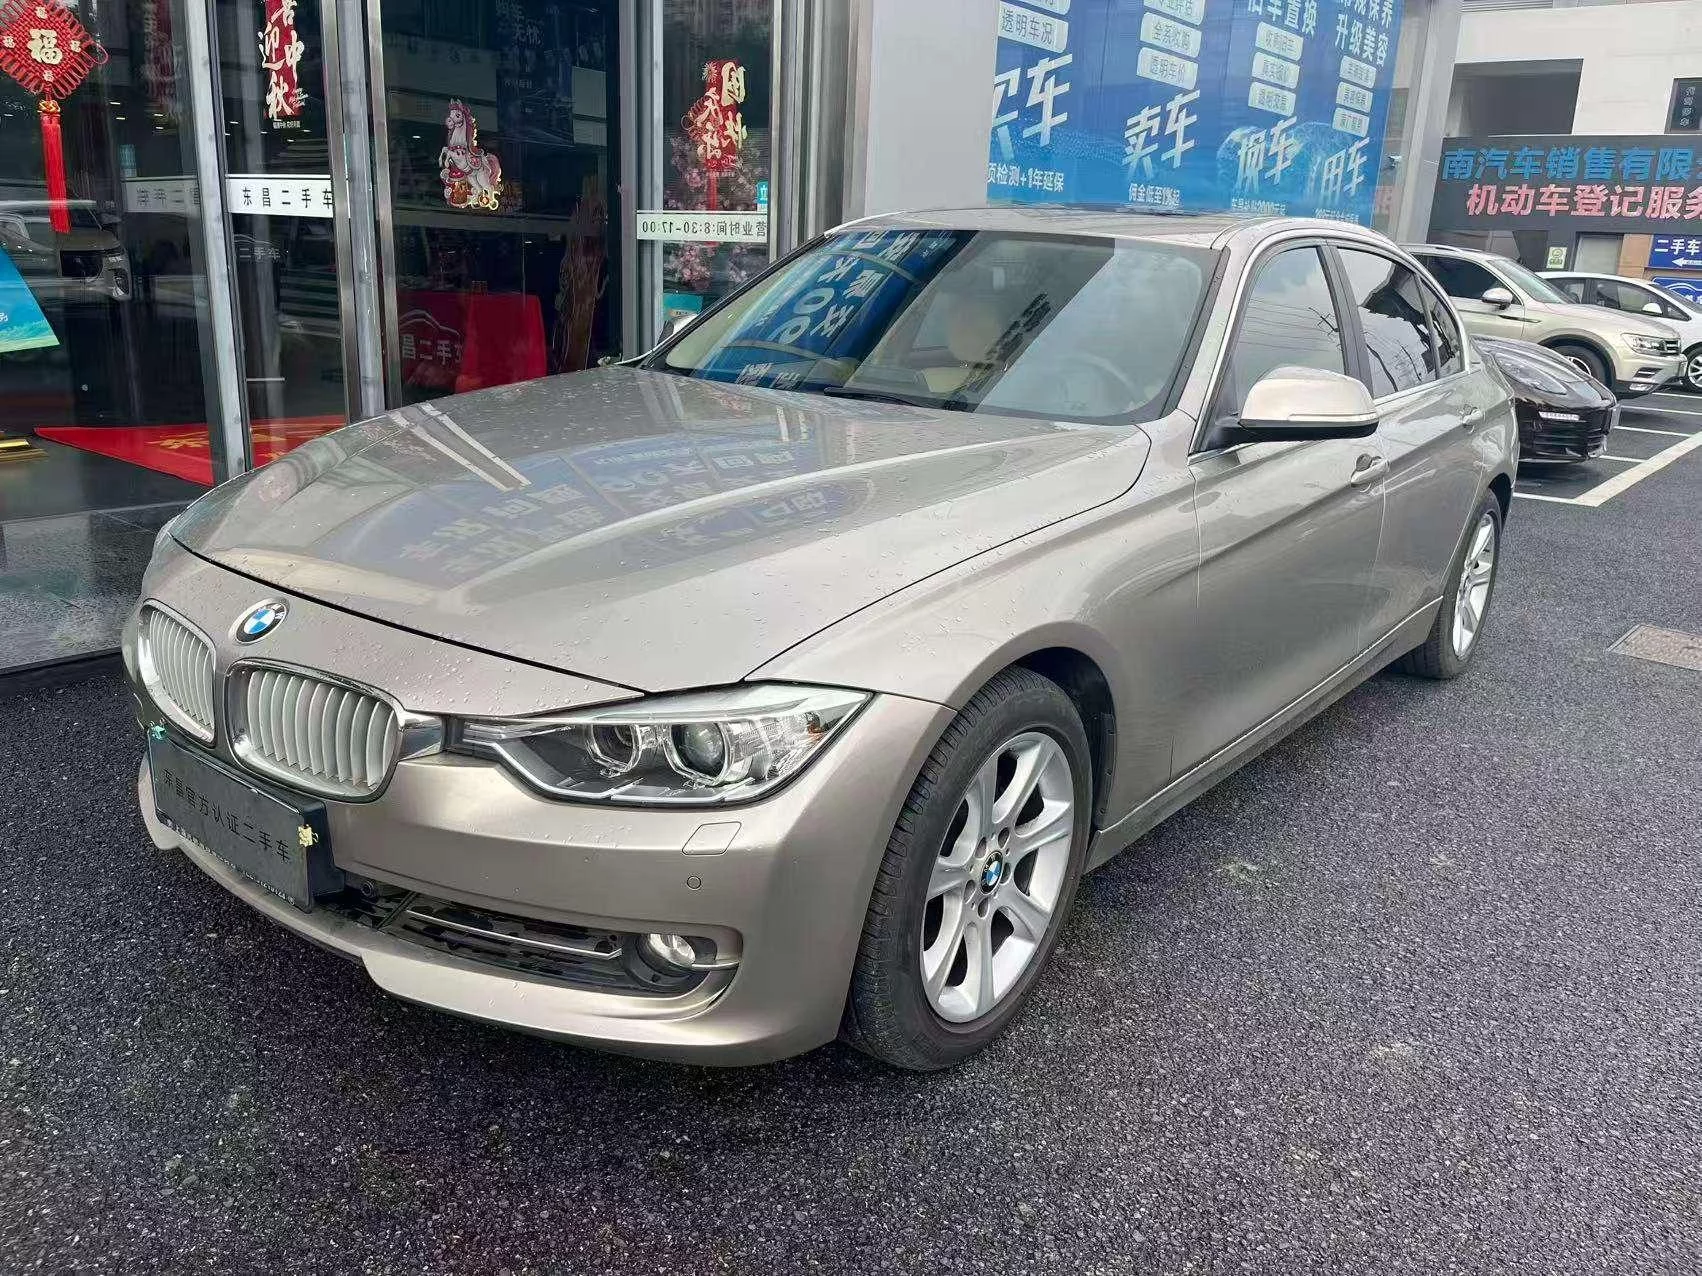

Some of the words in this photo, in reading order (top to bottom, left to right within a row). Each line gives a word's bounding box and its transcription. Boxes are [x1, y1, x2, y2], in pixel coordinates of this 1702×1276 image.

[1002, 8, 1054, 45] 透明车况
[1335, 13, 1389, 68] 升级美容
[1122, 90, 1200, 178] 卖车
[1441, 146, 1702, 183] 南汽车销售有限
[242, 187, 333, 209] 东昌二手车
[1655, 239, 1701, 255] 二手车
[162, 767, 290, 863] 东昌官方认证二手车
